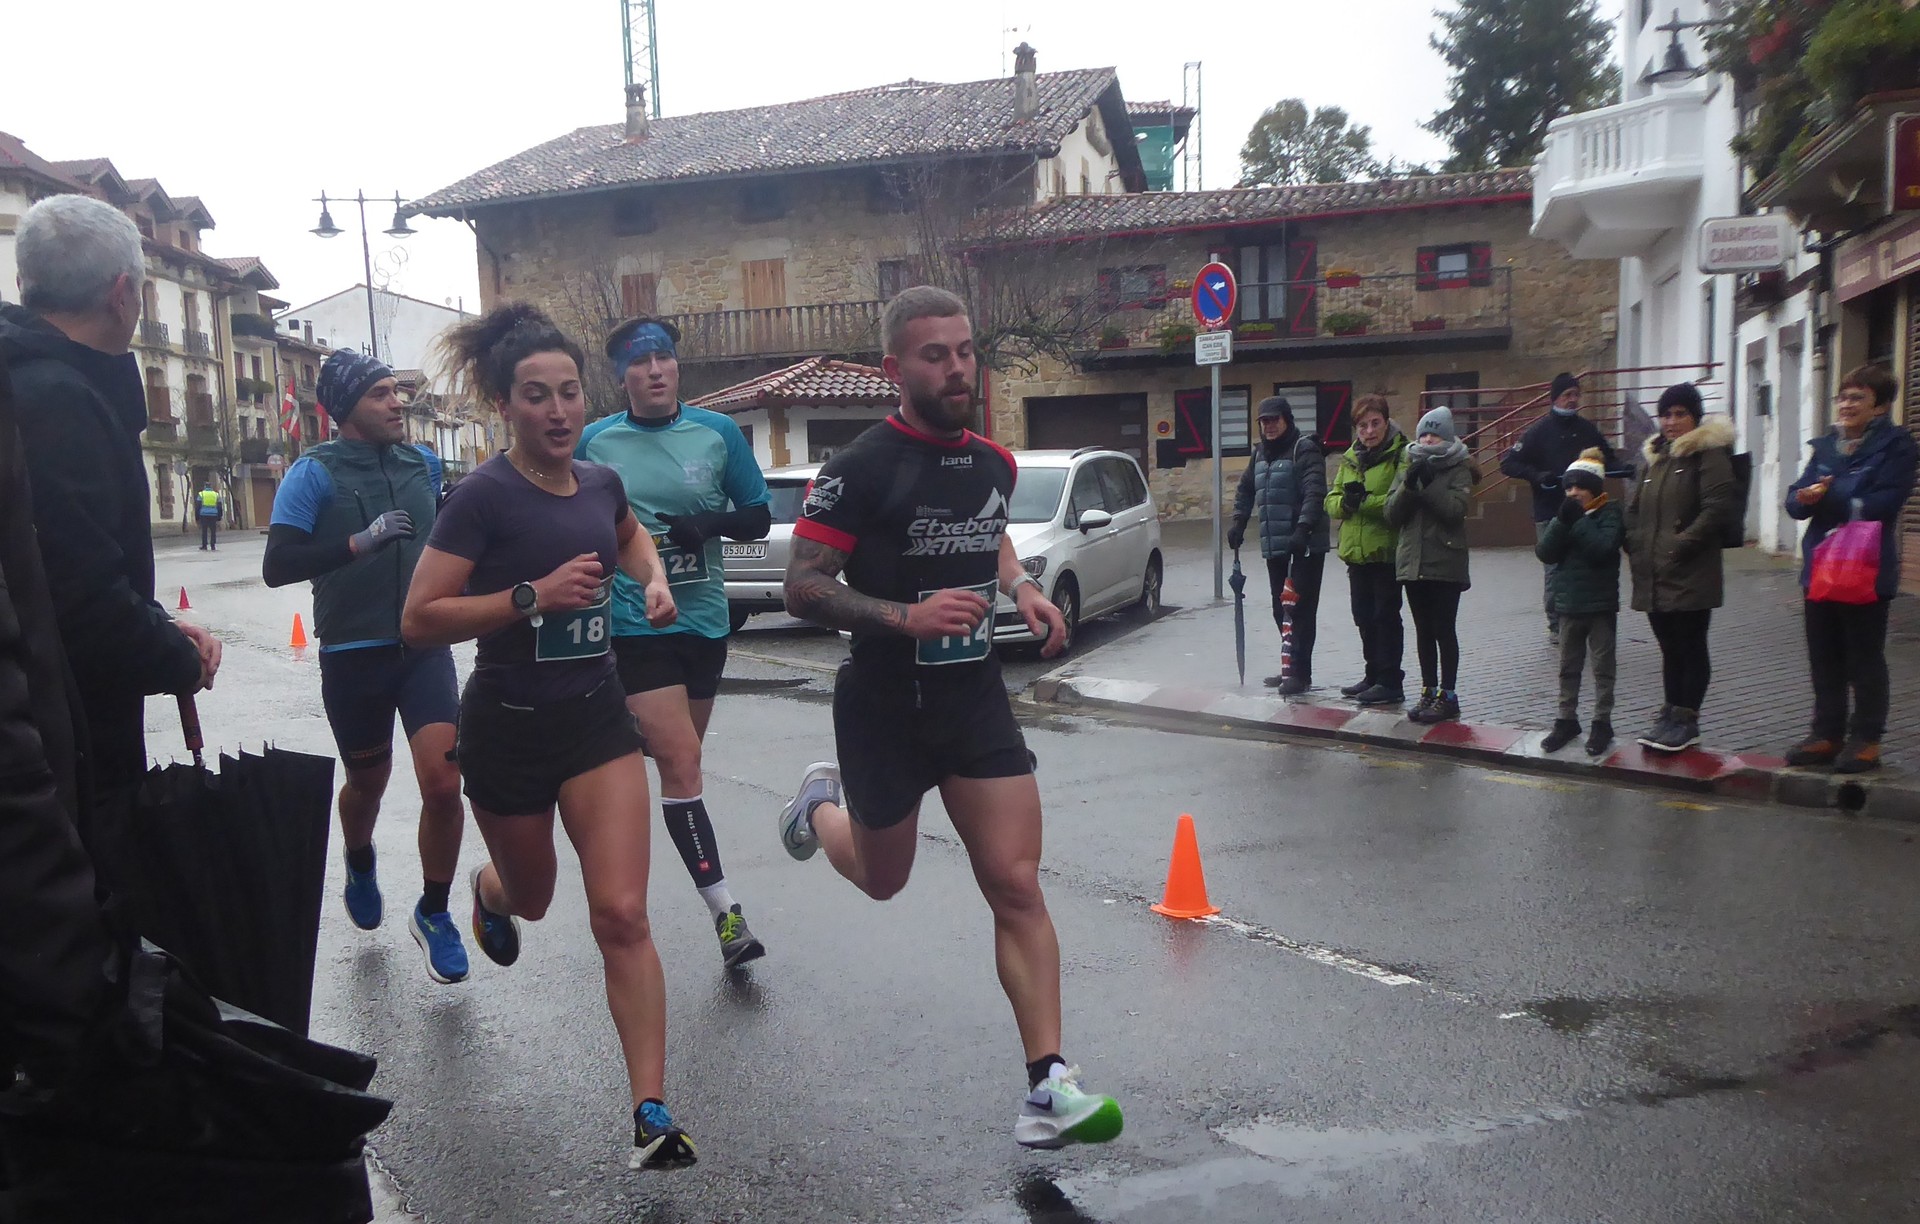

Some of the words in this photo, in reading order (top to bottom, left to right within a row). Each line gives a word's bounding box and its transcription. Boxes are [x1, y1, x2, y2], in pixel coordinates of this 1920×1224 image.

[1425, 420, 1441, 429] NY
[723, 545, 744, 555] 8530
[746, 544, 763, 555] DKV
[566, 616, 604, 644] 18
